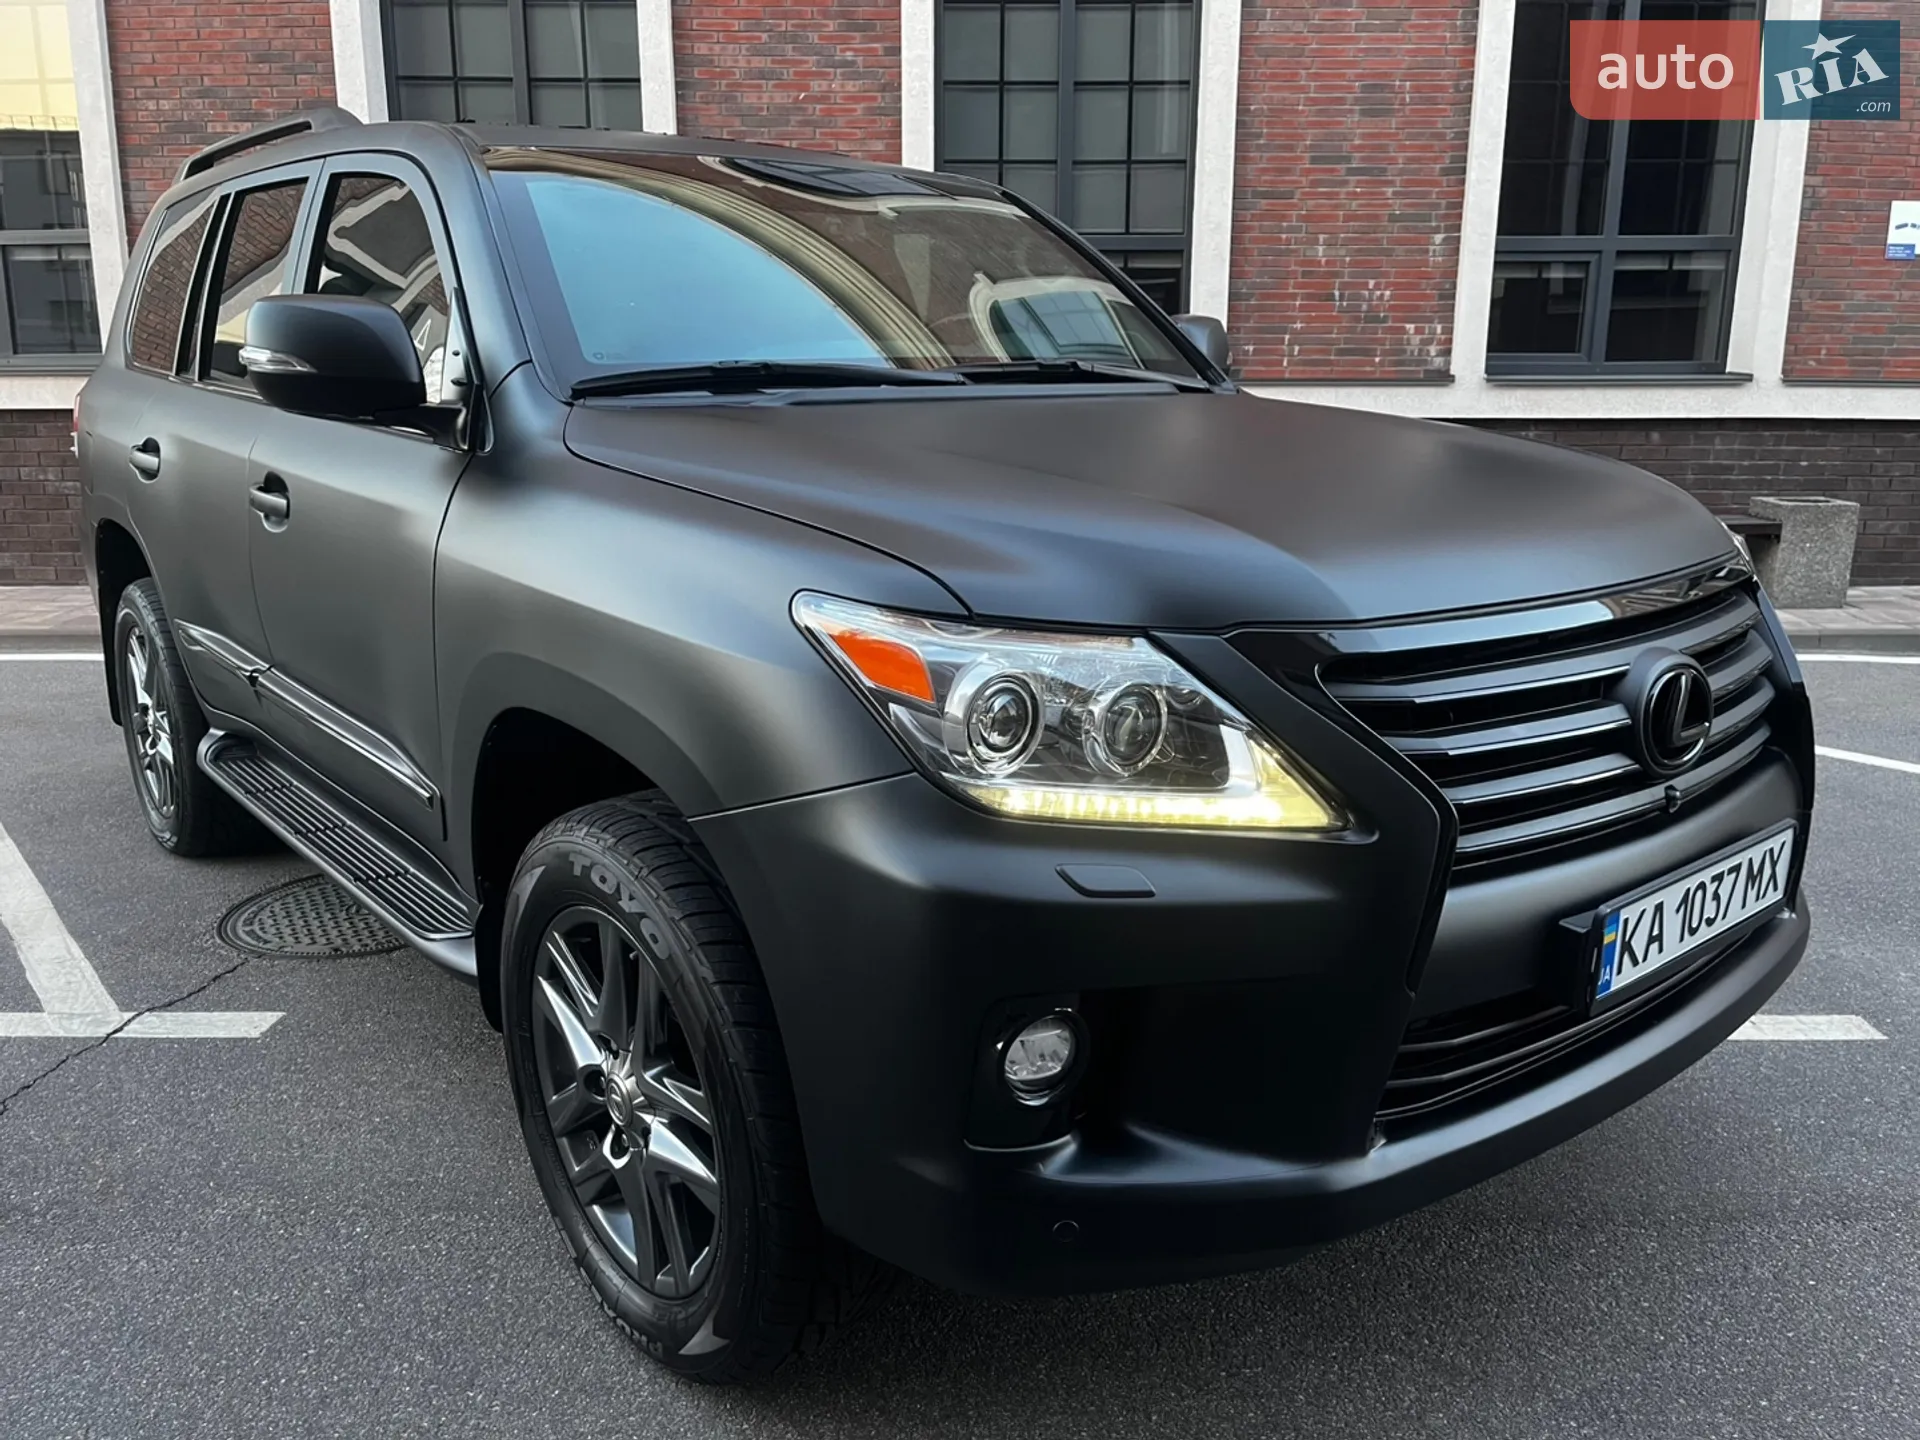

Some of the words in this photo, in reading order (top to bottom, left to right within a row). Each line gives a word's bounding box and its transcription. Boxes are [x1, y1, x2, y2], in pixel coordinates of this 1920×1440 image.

[568, 853, 672, 960] TOYO
[1616, 900, 1665, 976] KA
[1675, 861, 1743, 944] 1037
[1741, 840, 1787, 910] MX
